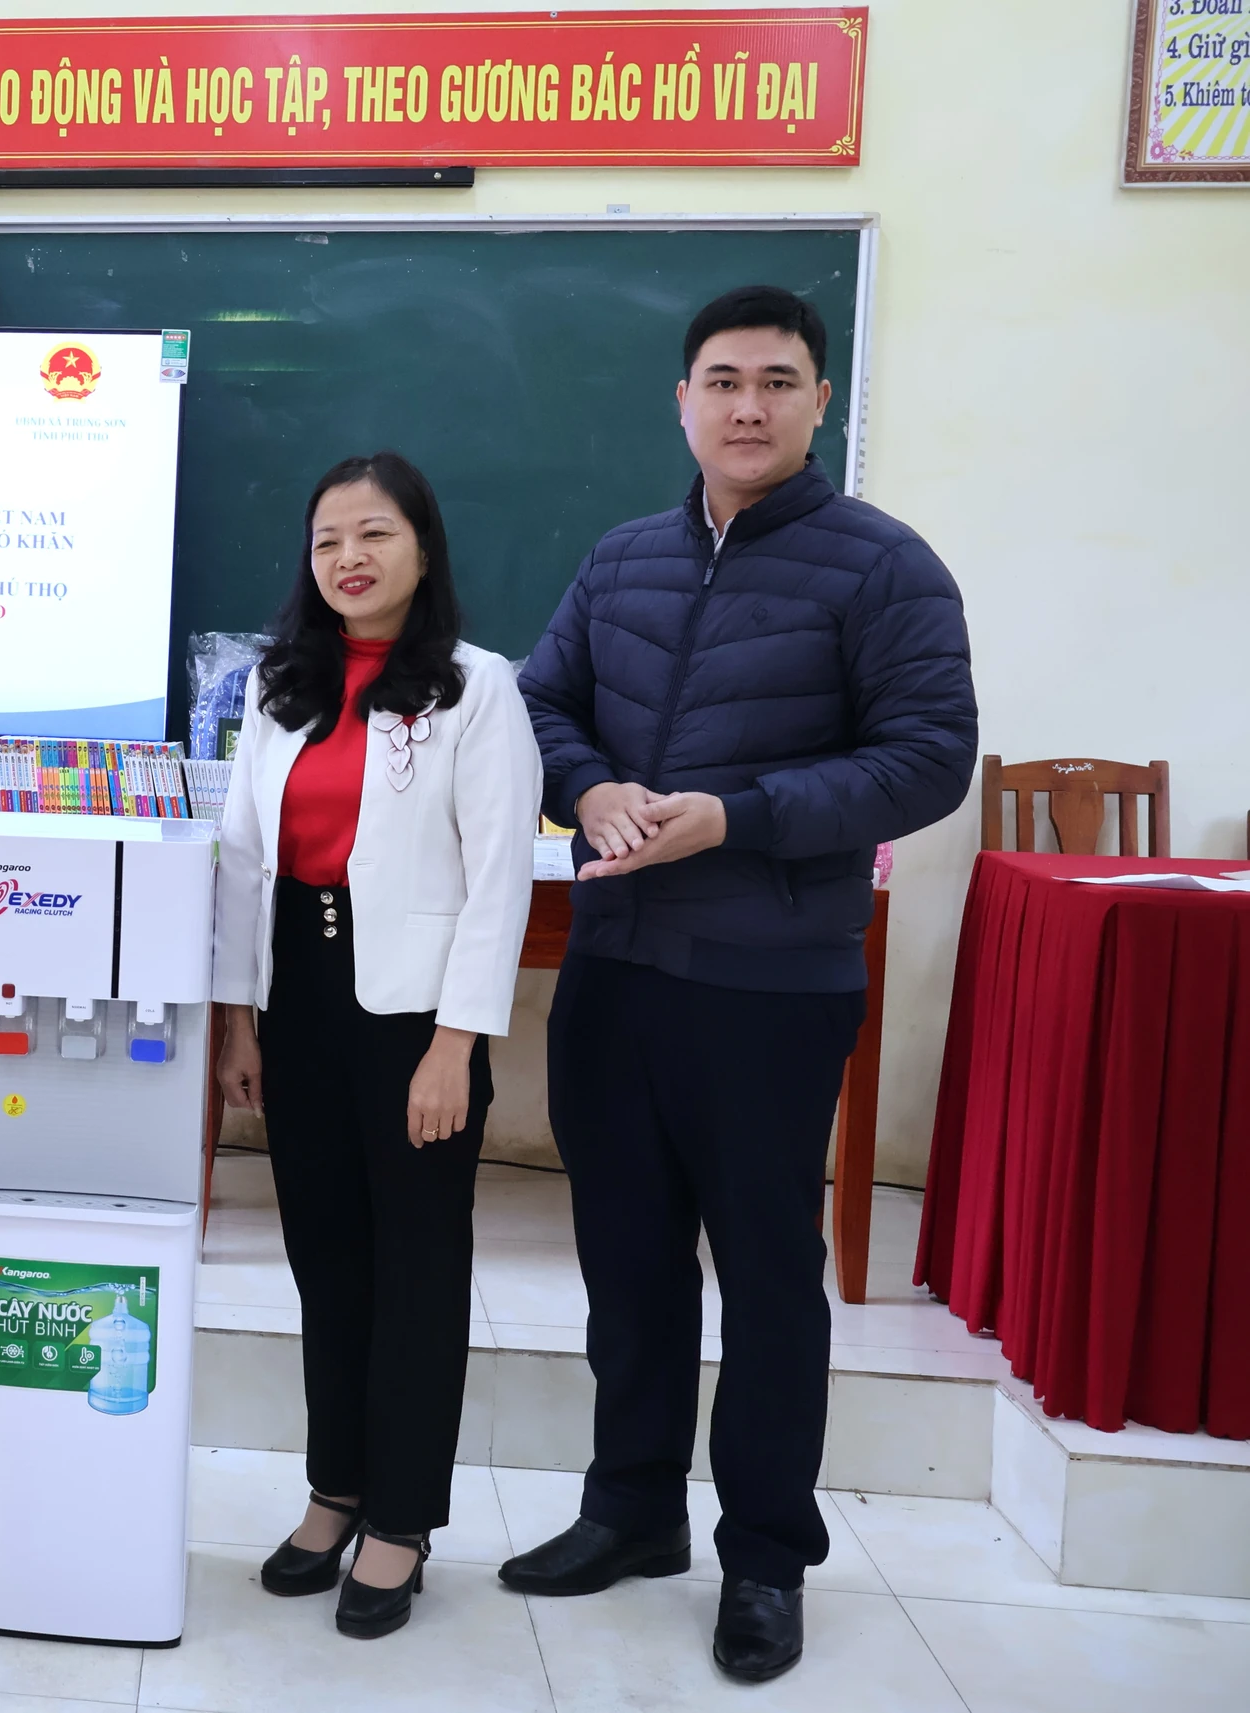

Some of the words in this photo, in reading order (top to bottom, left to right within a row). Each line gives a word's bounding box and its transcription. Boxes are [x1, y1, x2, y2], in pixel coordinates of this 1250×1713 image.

[1166, 36, 1181, 59] 4.
[1188, 33, 1226, 59] Giữ
[30, 57, 122, 137] ĐỘNG
[133, 56, 175, 124] VÀ
[186, 66, 252, 136] HỌC
[265, 55, 330, 136] TẬP,
[344, 65, 428, 123] THEO
[440, 58, 559, 122] GƯƠNG
[570, 51, 641, 122] BÁC
[653, 43, 700, 121] HỒ
[714, 50, 750, 121] VĨ
[756, 62, 818, 133] ĐẠI
[1165, 84, 1177, 107] 5.
[1182, 80, 1234, 107] Khiêm
[21, 510, 66, 526] NAM
[17, 531, 74, 550] KHĂN
[25, 581, 68, 602] THỌ
[8, 892, 82, 908] EXEDY
[15, 907, 42, 915] RACING
[38, 1301, 92, 1323] NƯỚC
[35, 1319, 77, 1337] BÌNH
